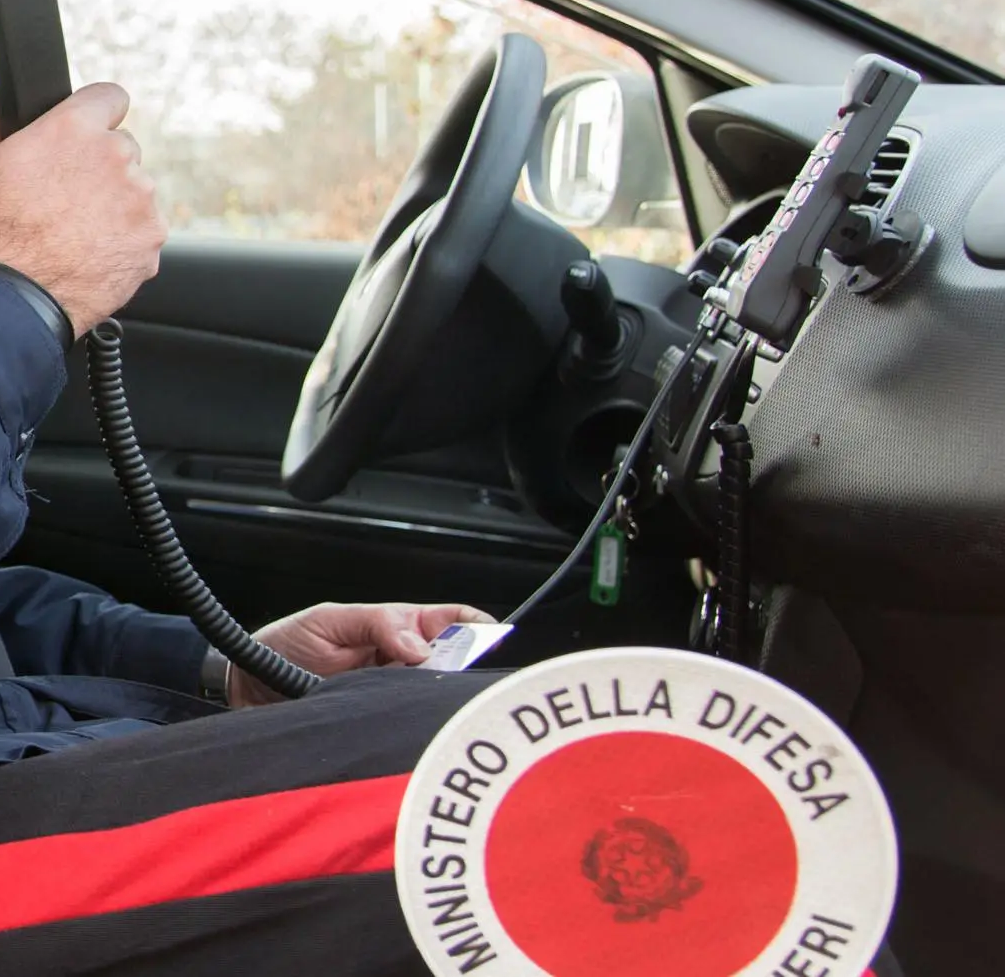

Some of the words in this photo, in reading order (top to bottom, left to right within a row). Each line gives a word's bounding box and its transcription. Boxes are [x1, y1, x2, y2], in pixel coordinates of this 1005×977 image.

[421, 739, 509, 975] MINISTERO
[510, 678, 674, 744] DELLA
[698, 690, 851, 821] DIFESA
